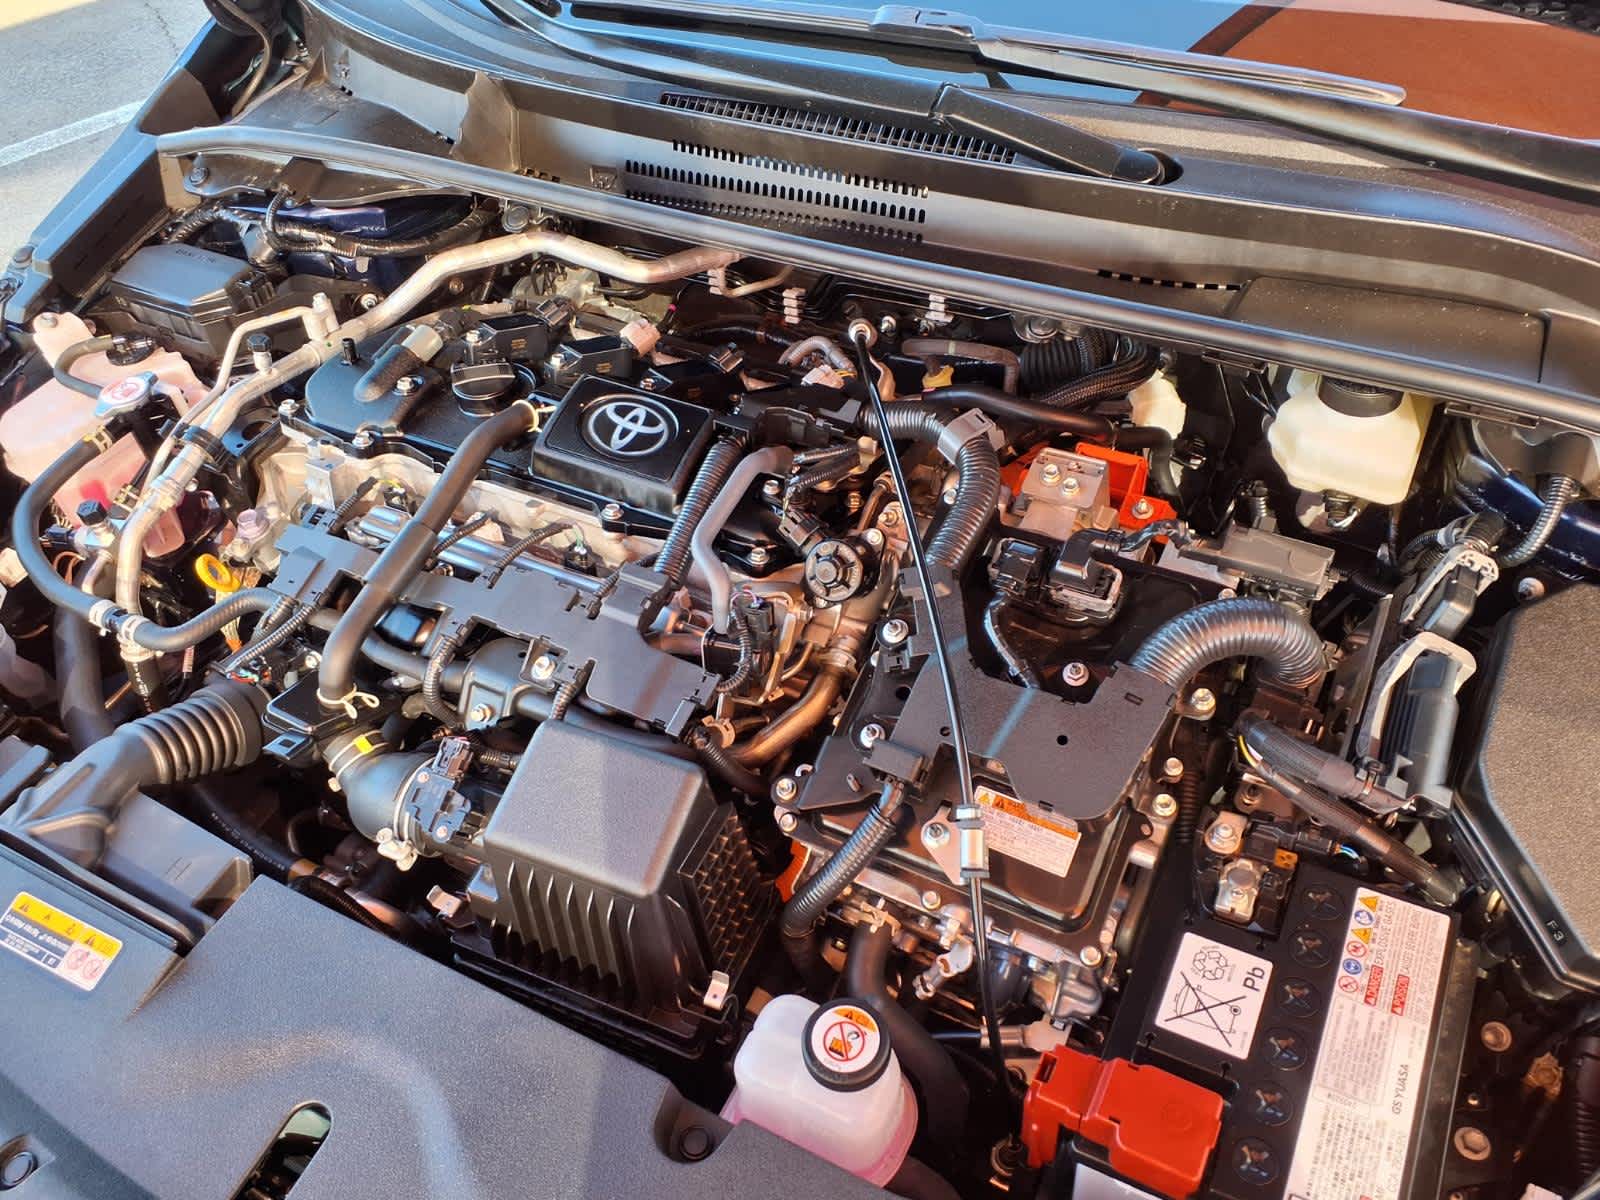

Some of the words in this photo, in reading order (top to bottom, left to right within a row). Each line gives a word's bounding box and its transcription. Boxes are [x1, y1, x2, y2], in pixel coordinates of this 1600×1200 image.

[1546, 920, 1565, 941] F3
[1243, 966, 1265, 992] Pb
[1395, 1064, 1409, 1099] YUASA
[1392, 1101, 1403, 1115] GS
